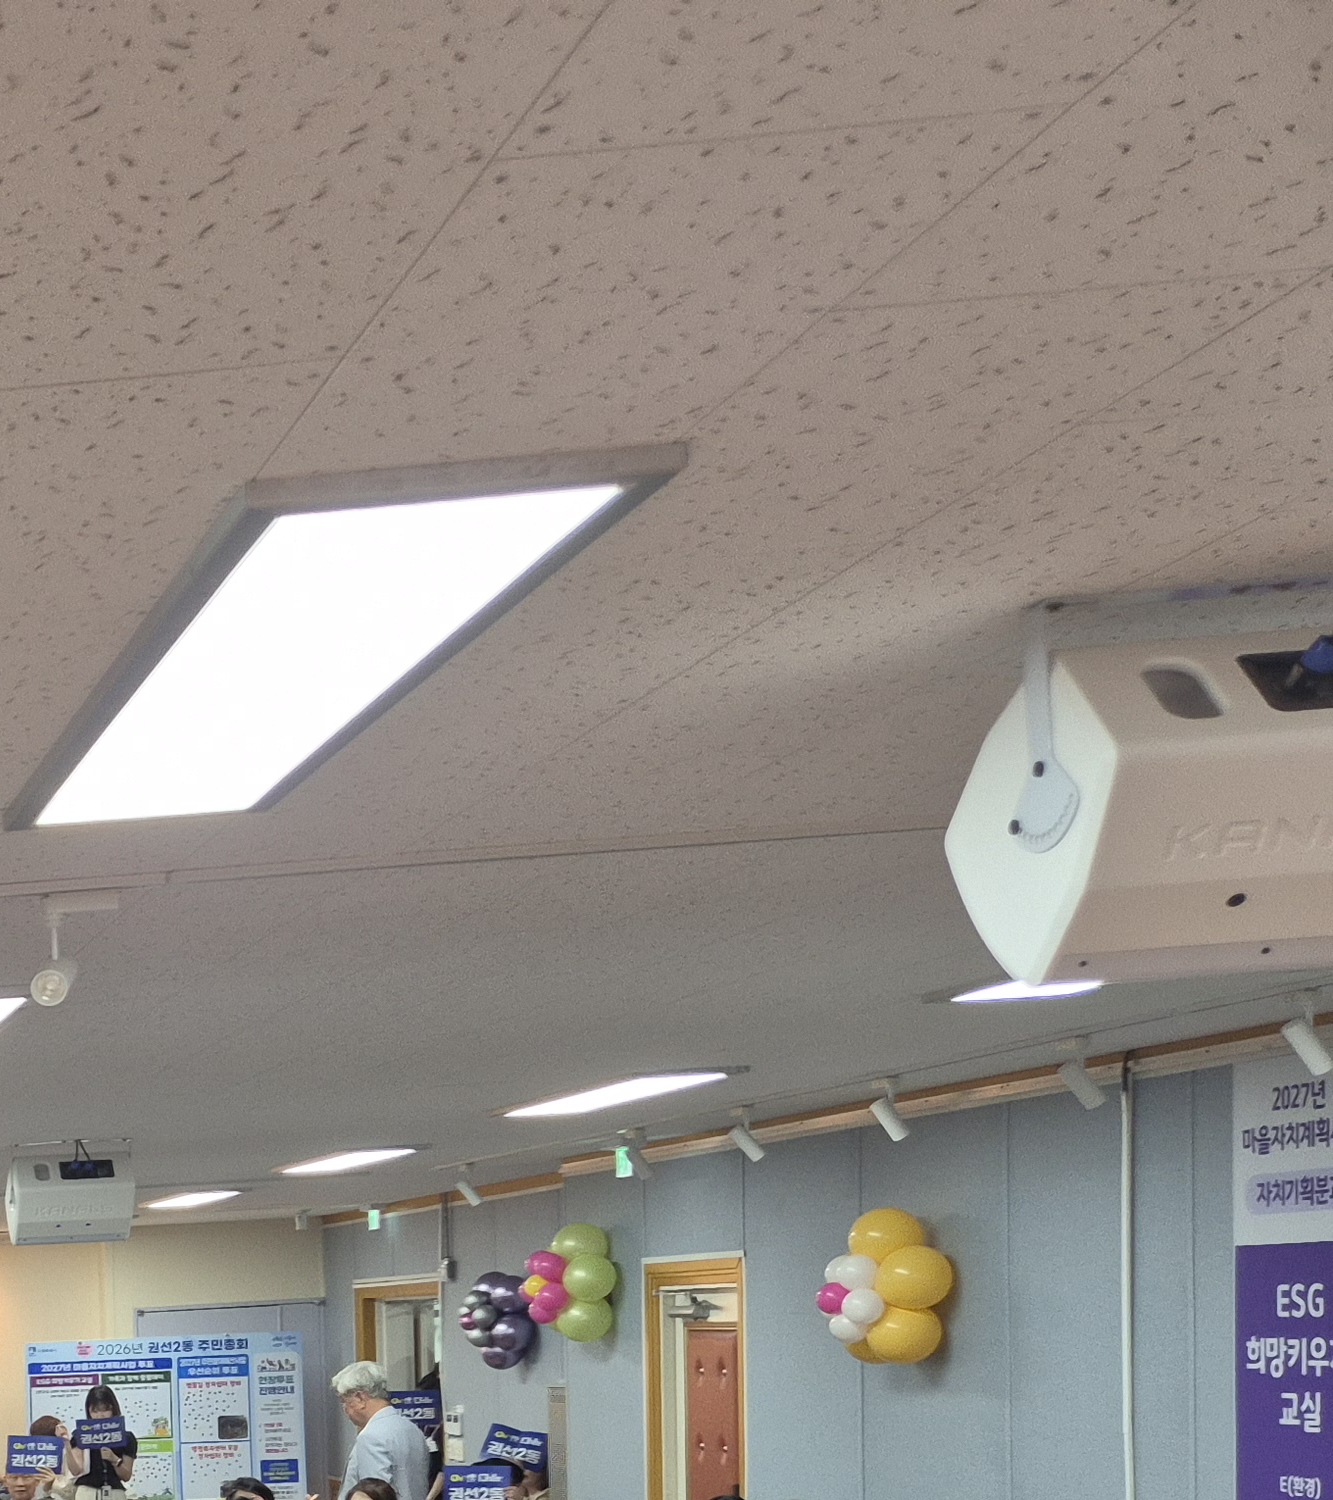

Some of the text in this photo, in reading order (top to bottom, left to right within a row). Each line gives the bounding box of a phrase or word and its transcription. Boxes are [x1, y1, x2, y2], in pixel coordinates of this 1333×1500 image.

[1272, 1080, 1326, 1111] 2027년
[1242, 1117, 1333, 1155] 마을자치계획
[1276, 1283, 1325, 1318] ESG
[97, 1342, 143, 1356] 2026년
[148, 1340, 194, 1354] 권선2동
[197, 1338, 249, 1351] 주민총회
[1246, 1335, 1333, 1378] 희망키우
[1279, 1392, 1321, 1433] 교실
[10, 1453, 59, 1469] 권선2동
[487, 1439, 542, 1465] 권선2동
[1279, 1475, 1321, 1500] E(환경)
